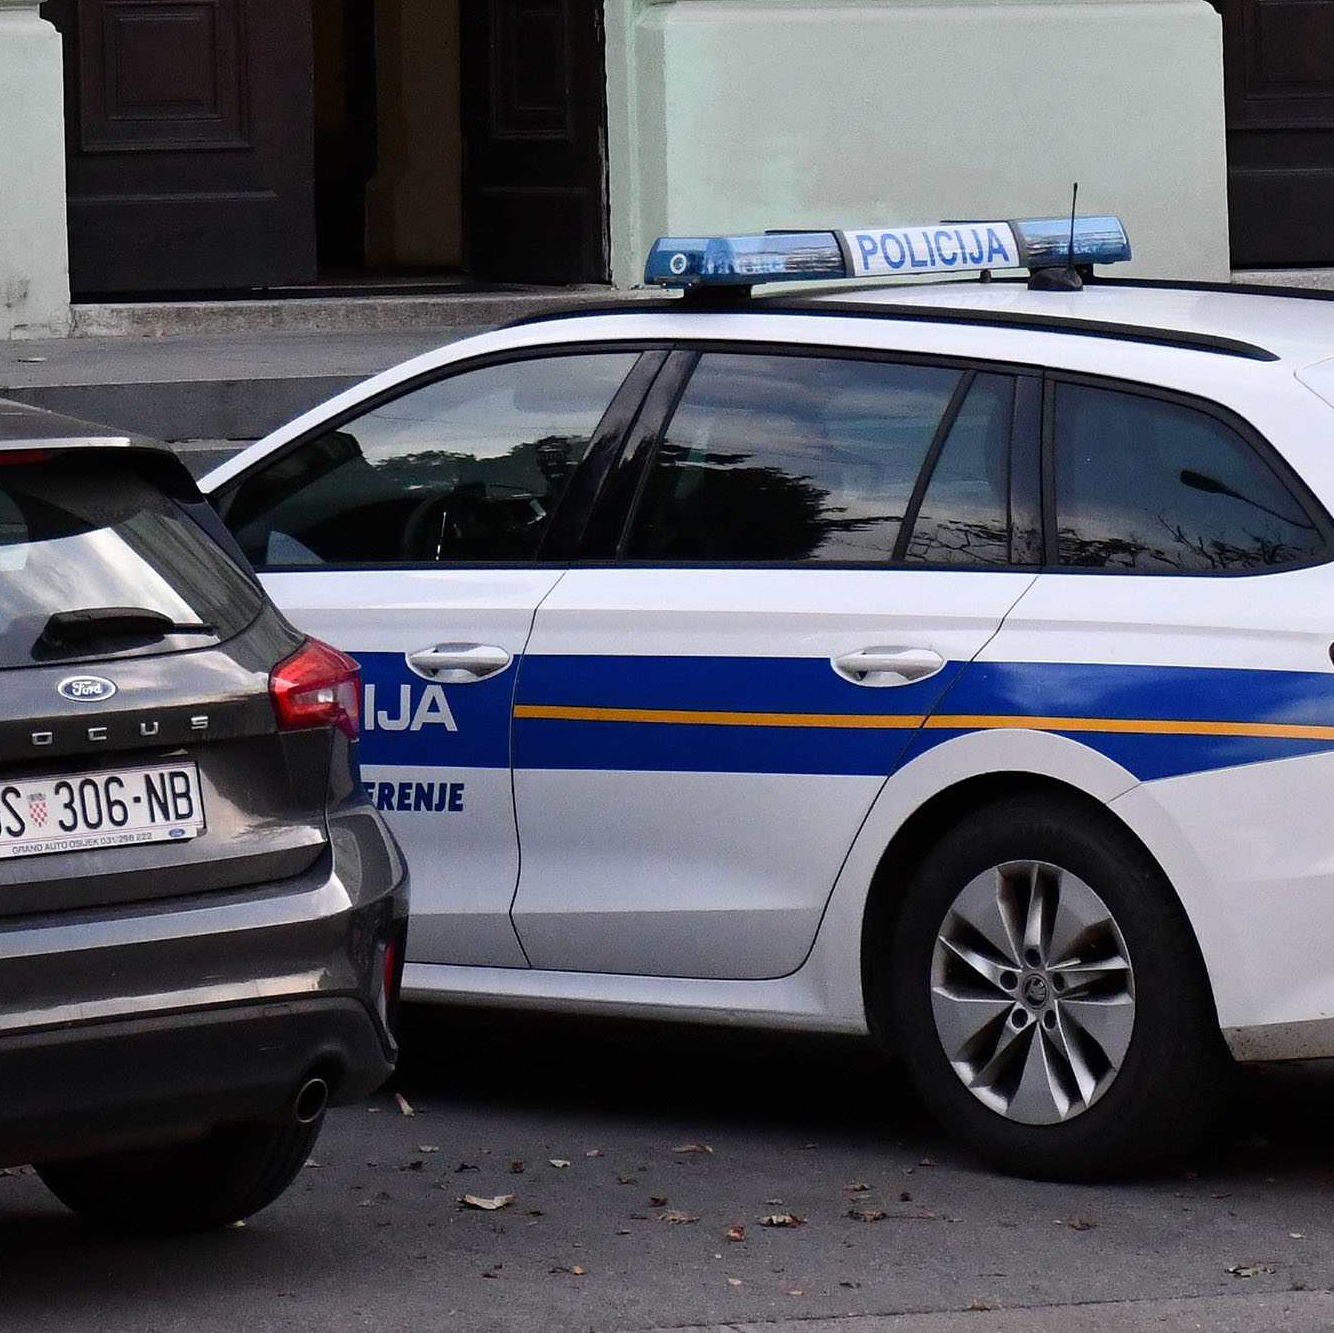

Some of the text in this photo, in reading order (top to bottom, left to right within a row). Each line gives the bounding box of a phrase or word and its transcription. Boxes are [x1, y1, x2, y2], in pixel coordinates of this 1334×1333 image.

[855, 228, 1010, 270] POLICIJA
[364, 684, 458, 732] IJA
[54, 770, 195, 832] 306-NB
[12, 844, 43, 854] GRAND
[44, 841, 68, 851] AUTO
[69, 838, 99, 849] OSIJEK
